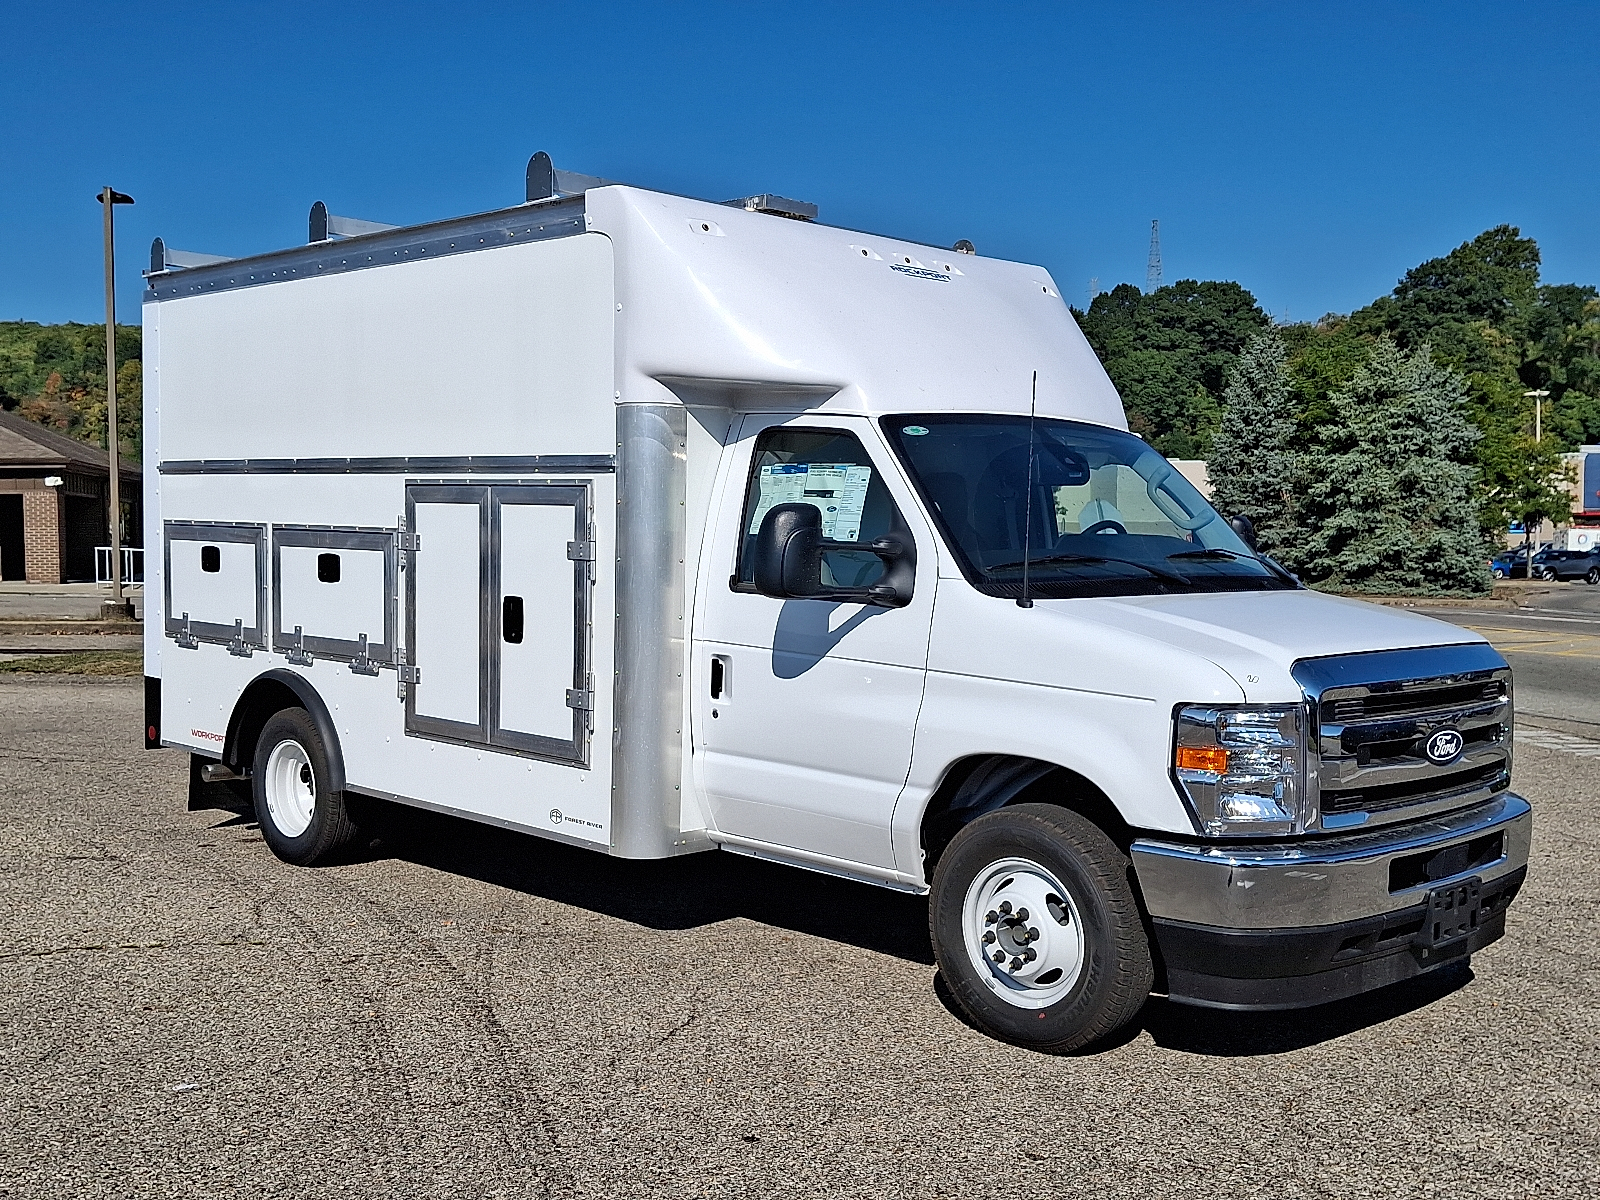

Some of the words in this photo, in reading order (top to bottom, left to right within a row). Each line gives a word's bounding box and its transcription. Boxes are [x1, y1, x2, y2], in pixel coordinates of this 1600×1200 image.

[889, 264, 951, 281] ROCKPORT
[1433, 734, 1457, 757] Ford
[564, 816, 586, 825] FOREST
[586, 821, 603, 830] RIVER
